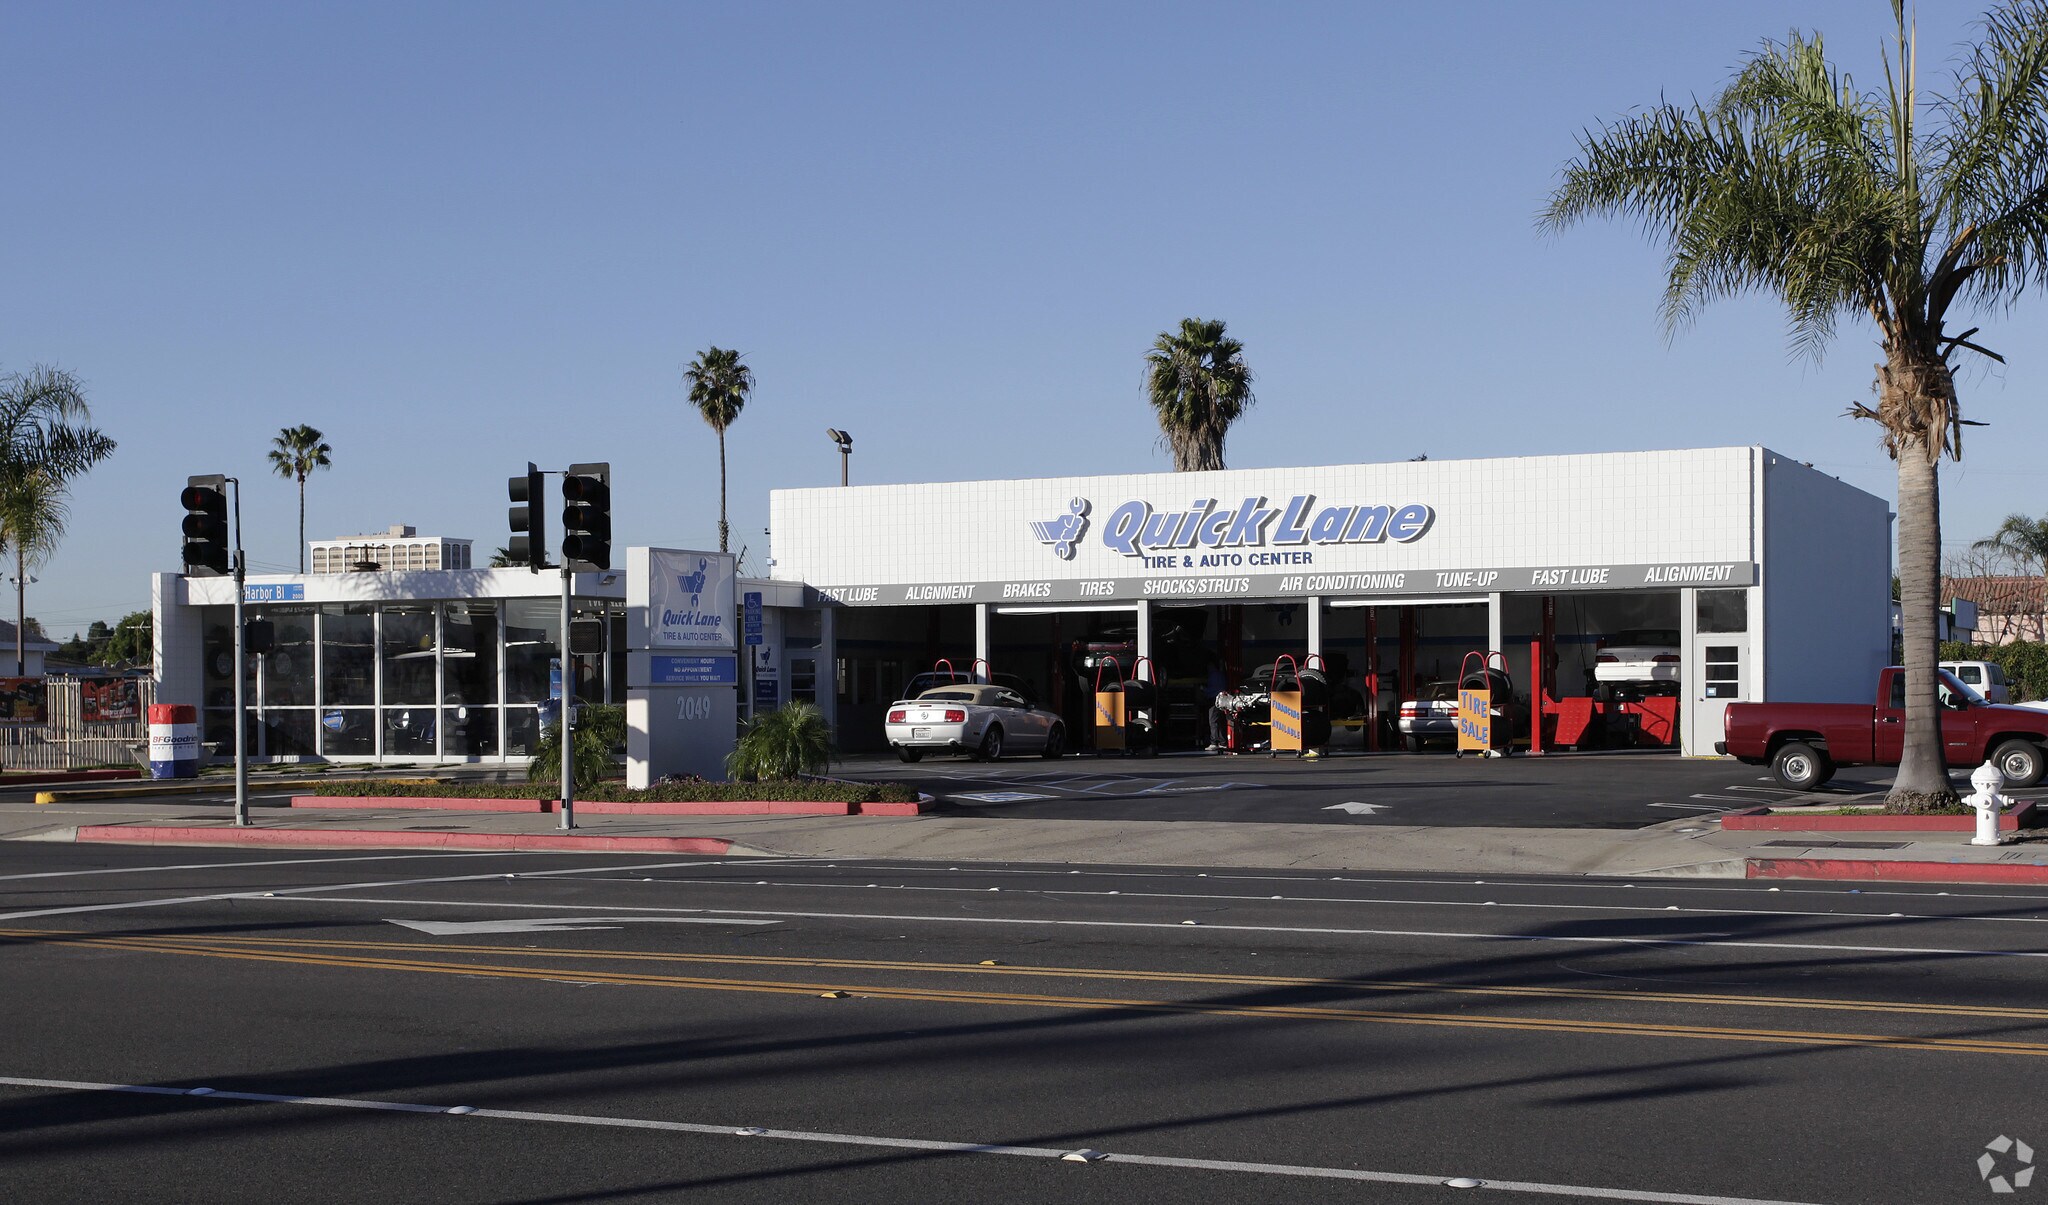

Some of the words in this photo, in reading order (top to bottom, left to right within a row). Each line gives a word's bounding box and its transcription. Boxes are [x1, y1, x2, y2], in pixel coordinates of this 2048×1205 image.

[1102, 496, 1277, 557] Quick
[1271, 495, 1436, 546] Lane
[1142, 556, 1177, 569] TIRE
[1183, 555, 1193, 567] &
[1200, 554, 1242, 567] AUTO
[1249, 552, 1313, 565] CENTER
[1436, 571, 1498, 587] TUNE-UP
[1531, 570, 1568, 585] FAST
[1571, 568, 1610, 584] LUBE
[1644, 565, 1735, 583] ALIGNMENT
[1003, 583, 1051, 598] BRAKES
[1079, 581, 1115, 597] TIRES
[1143, 578, 1250, 594] SHOCKS/STRUTS
[1279, 576, 1304, 592] AIR
[1306, 574, 1405, 591] CONDITIONING
[245, 586, 273, 600] Harbor
[817, 588, 847, 602] FAST
[848, 587, 879, 602] LUBE
[905, 585, 976, 600] ALIGNMENT
[662, 609, 694, 627] Quick
[694, 611, 722, 627] Lane
[663, 632, 676, 640] TIRE
[677, 632, 683, 640] &
[683, 632, 699, 640] AUTO
[700, 632, 723, 641] CENTER
[676, 695, 711, 720] 2049
[1272, 700, 1300, 721] FINANCING
[1461, 691, 1488, 718] TIRE
[1272, 719, 1301, 739] AVAILABLE
[1461, 718, 1489, 744] SALE
